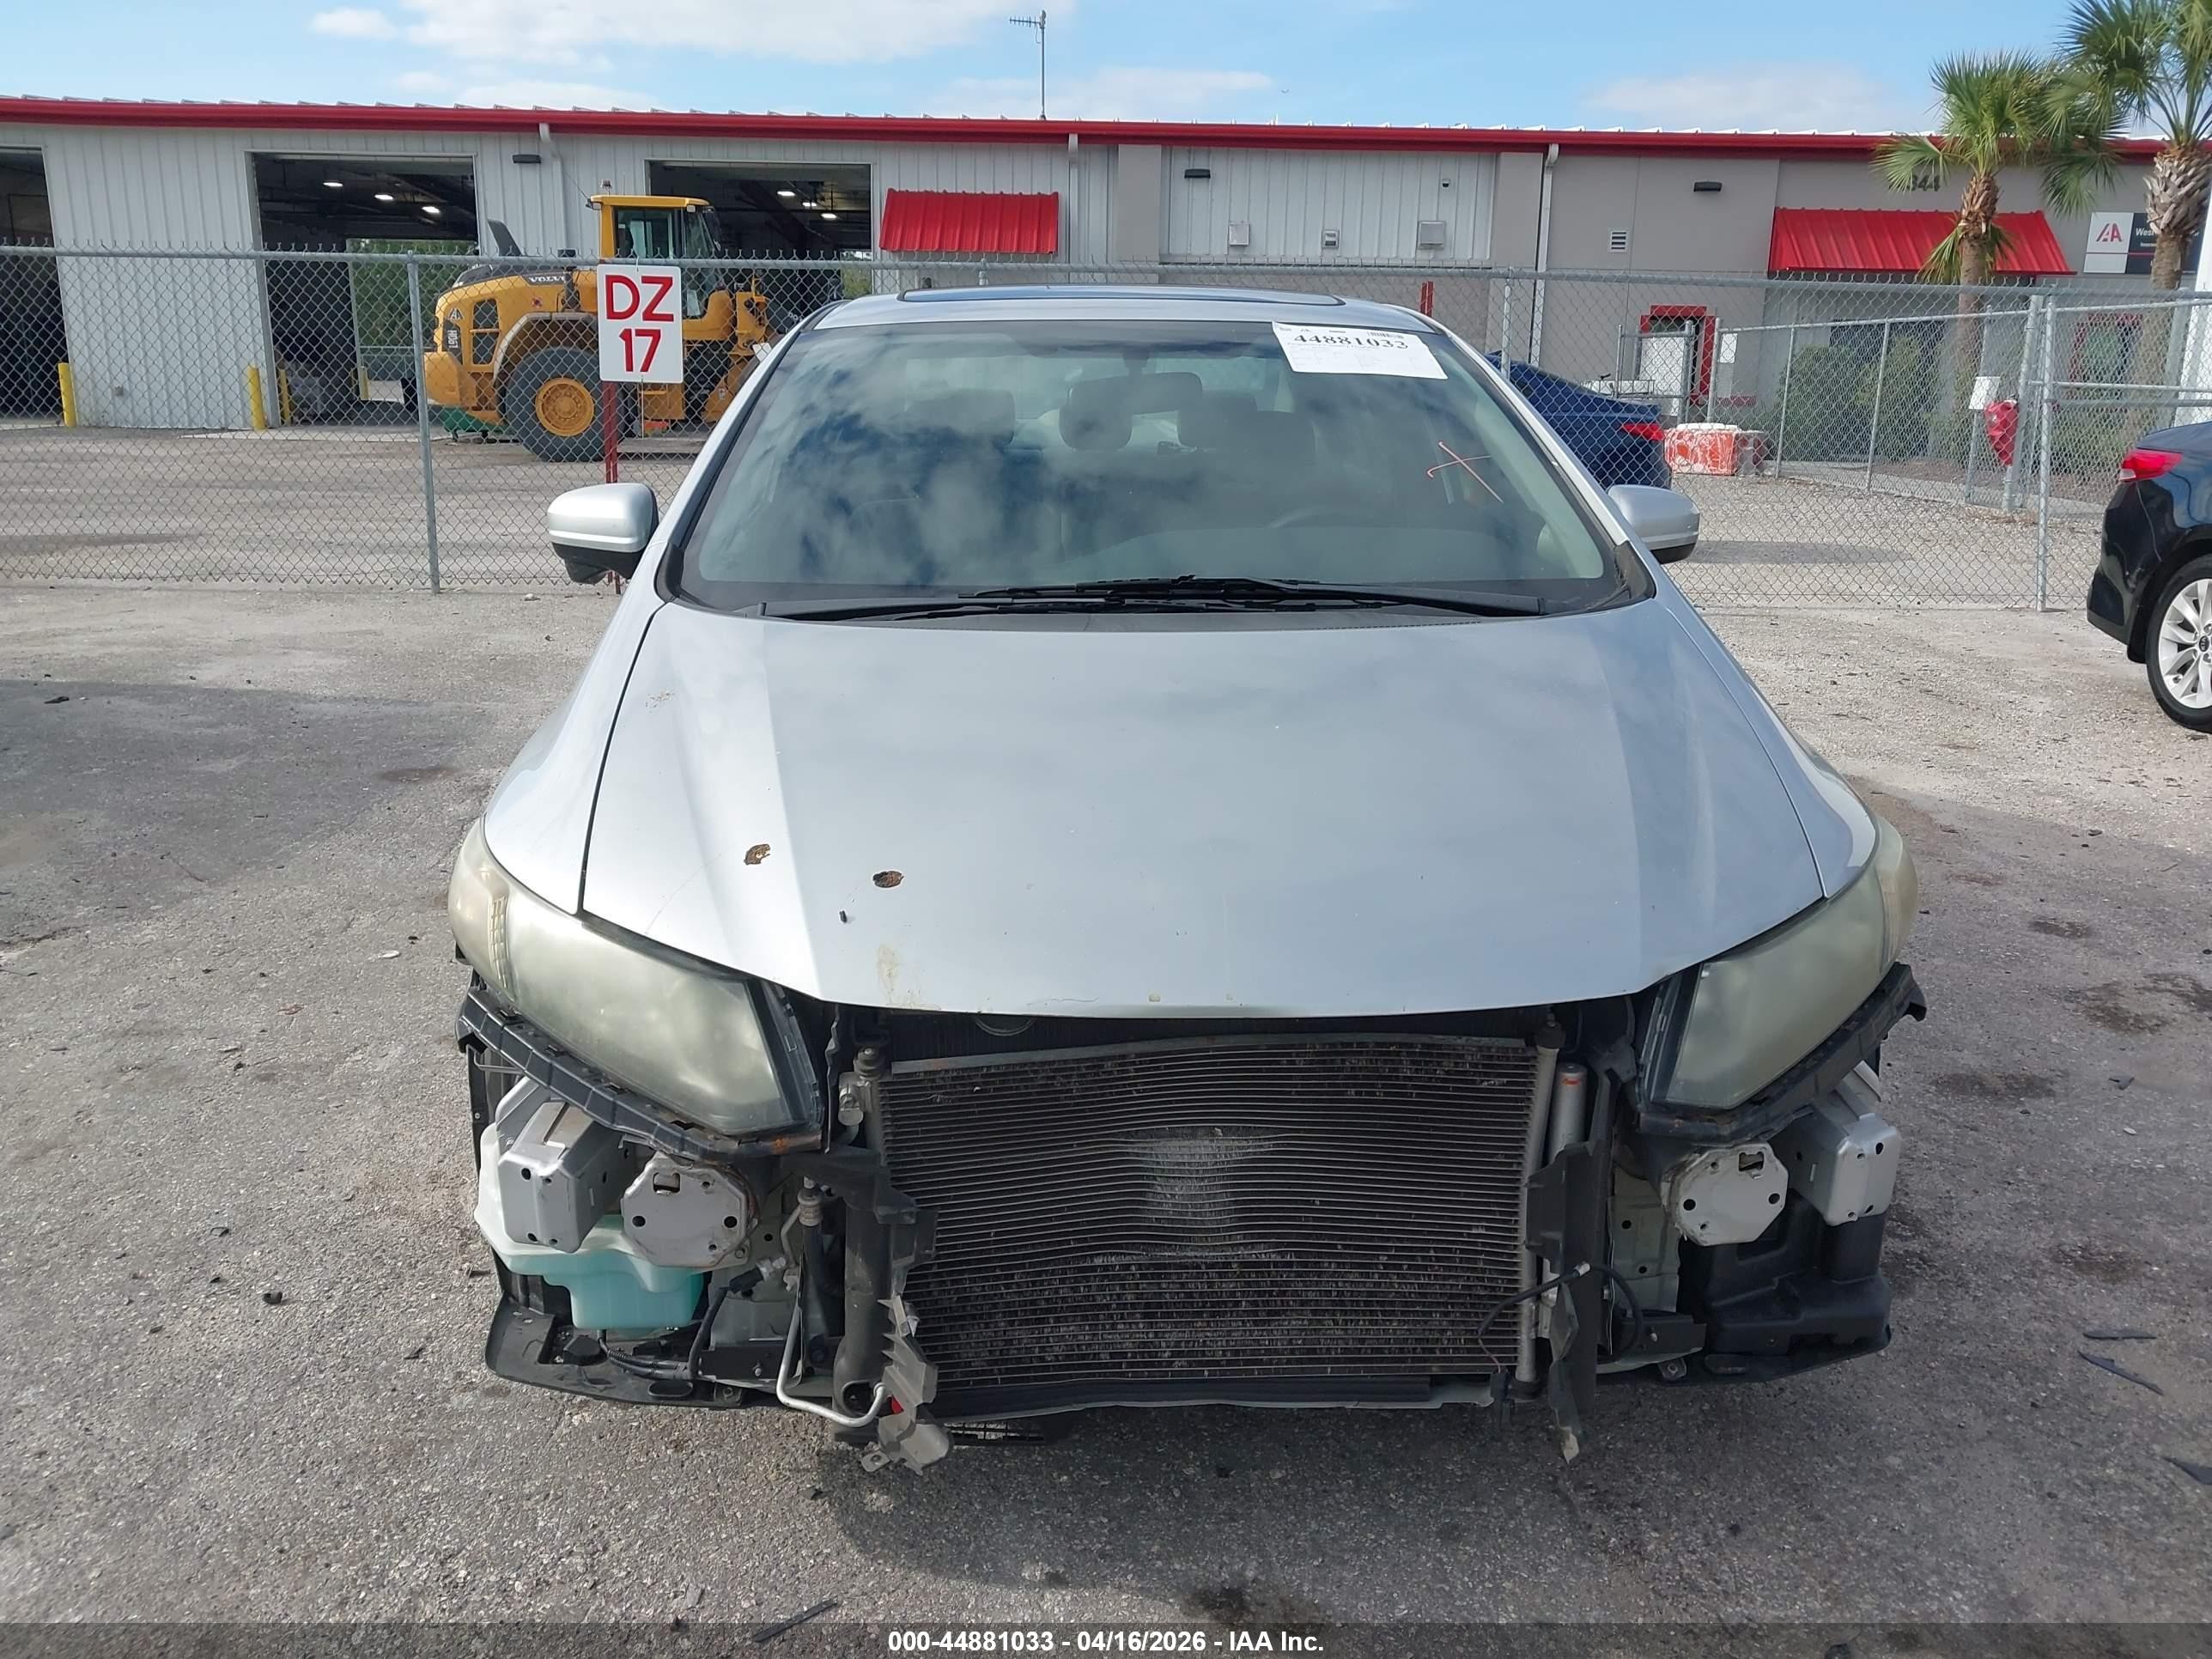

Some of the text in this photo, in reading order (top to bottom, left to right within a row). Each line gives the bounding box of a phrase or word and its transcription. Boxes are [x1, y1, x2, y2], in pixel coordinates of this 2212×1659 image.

[605, 274, 675, 322] DZ
[618, 328, 662, 373] 17
[1294, 334, 1409, 349] 44881033
